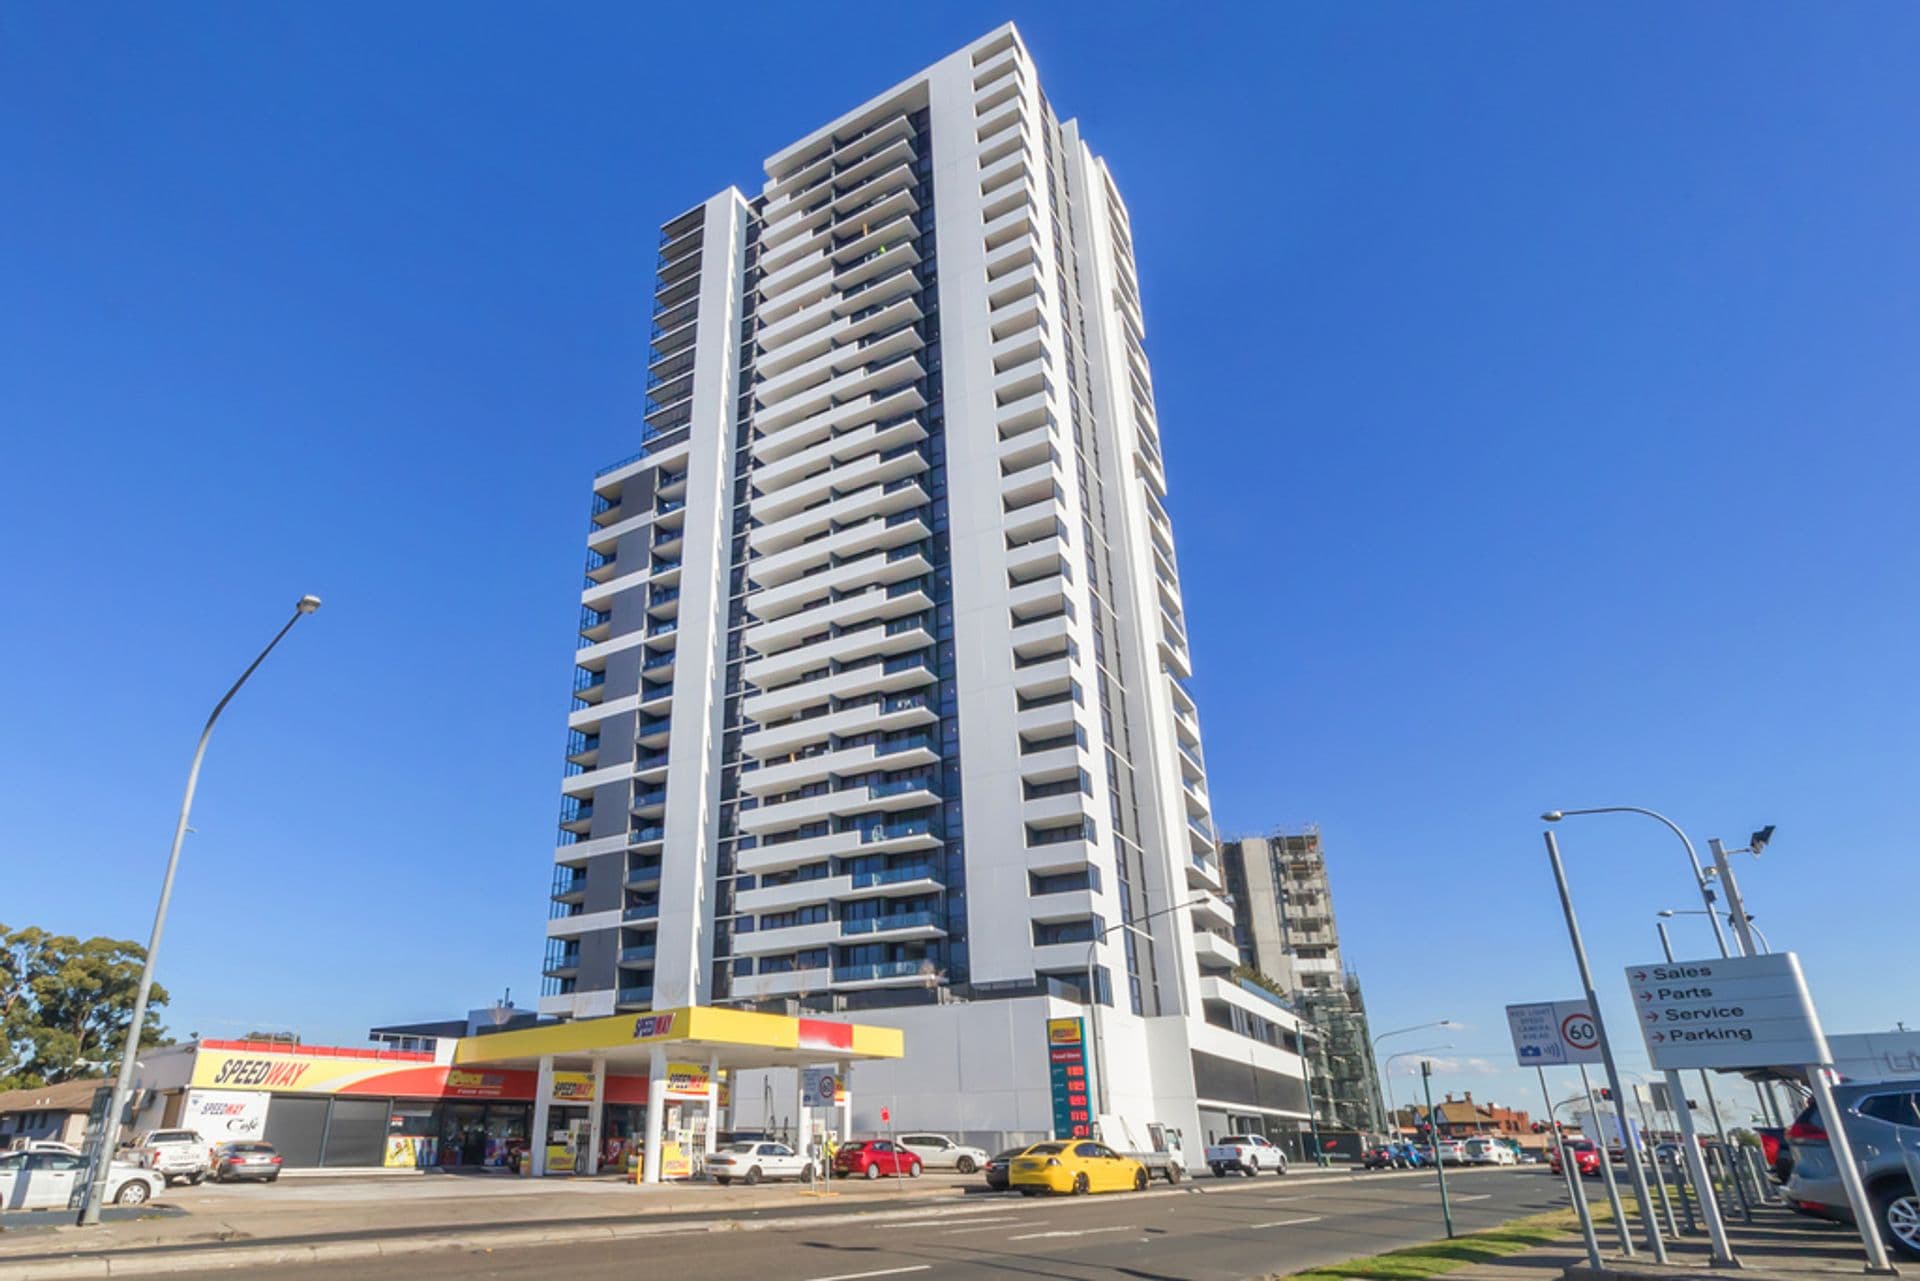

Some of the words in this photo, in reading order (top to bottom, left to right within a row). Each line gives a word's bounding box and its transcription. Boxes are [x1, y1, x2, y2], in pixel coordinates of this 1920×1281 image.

[1653, 966, 1712, 981] Sales
[1657, 986, 1713, 1001] Parts
[1665, 1006, 1744, 1022] Service
[633, 1014, 676, 1038] SPEEDWAY
[1569, 1023, 1595, 1040] 60
[1669, 1027, 1752, 1042] Parking
[214, 1059, 310, 1087] SPEEDWAY
[200, 1102, 246, 1115] SPEEDWAY
